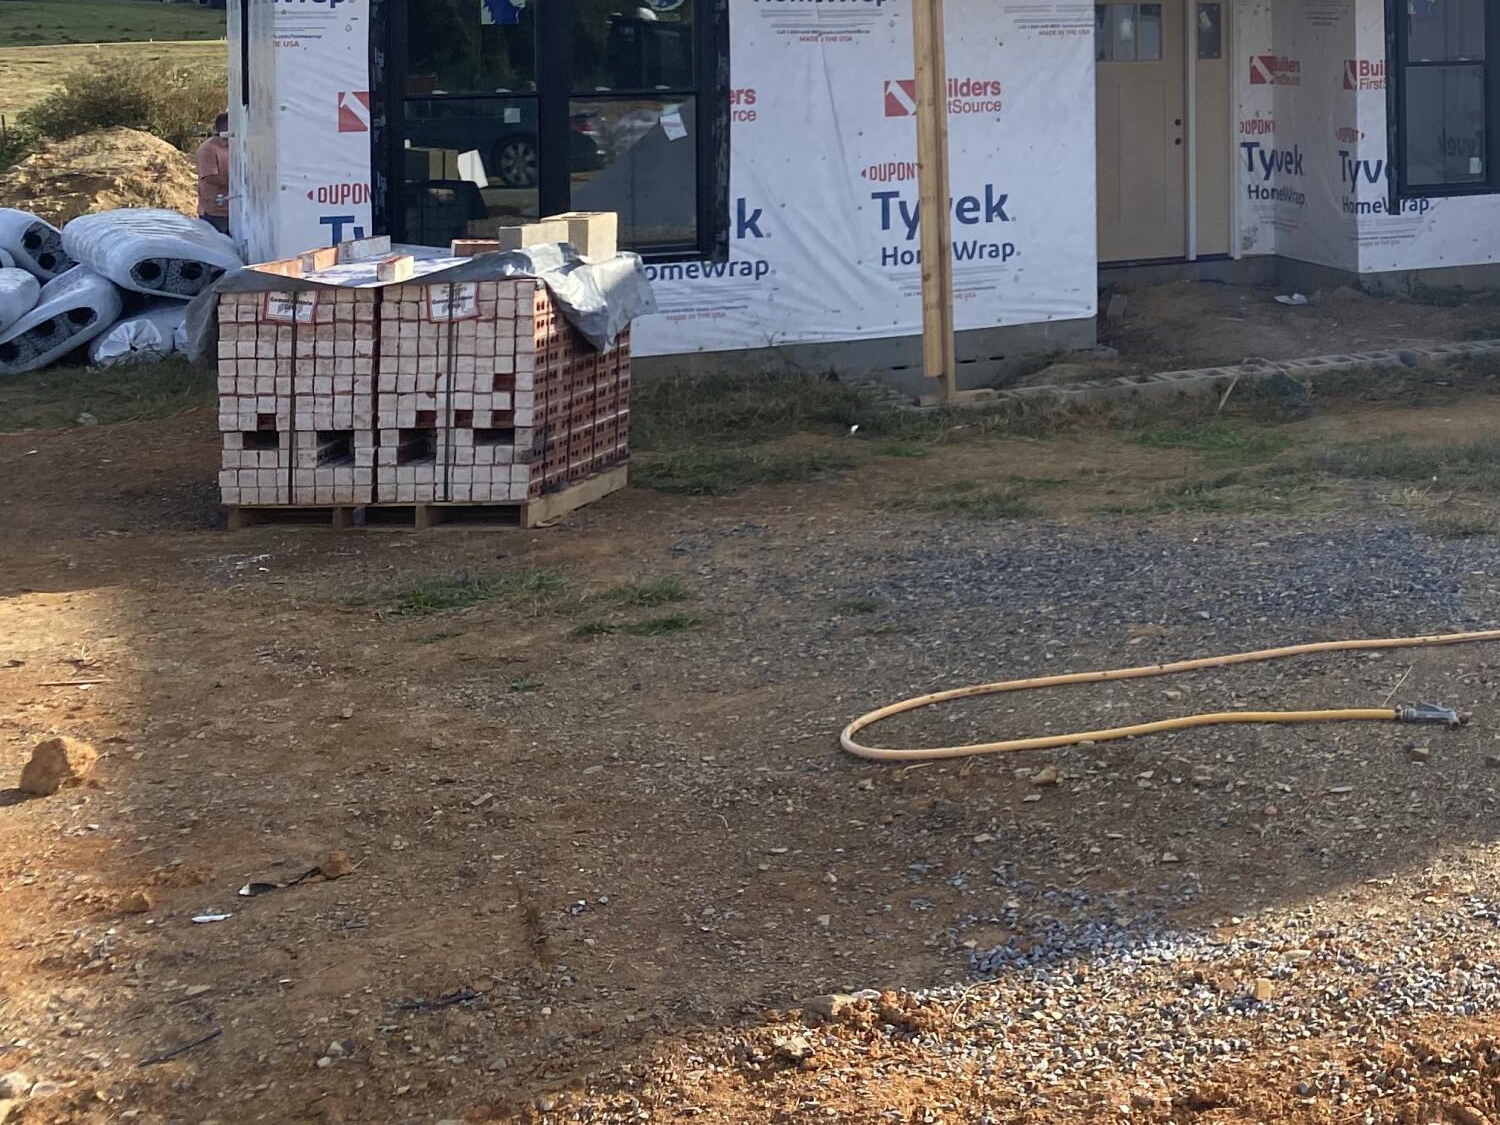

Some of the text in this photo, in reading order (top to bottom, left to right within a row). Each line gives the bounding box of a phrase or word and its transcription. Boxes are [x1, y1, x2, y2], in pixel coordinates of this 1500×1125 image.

[948, 78, 1001, 97] ilders
[948, 99, 1002, 114] tSource
[1240, 141, 1303, 180] Tyvek
[1339, 150, 1387, 193] Tyv
[318, 183, 371, 205] DUPON
[1248, 184, 1306, 206] HomeWrap
[871, 184, 1010, 241] Tyek
[881, 240, 1015, 267] HoWrap
[645, 259, 769, 281] omeWrap
